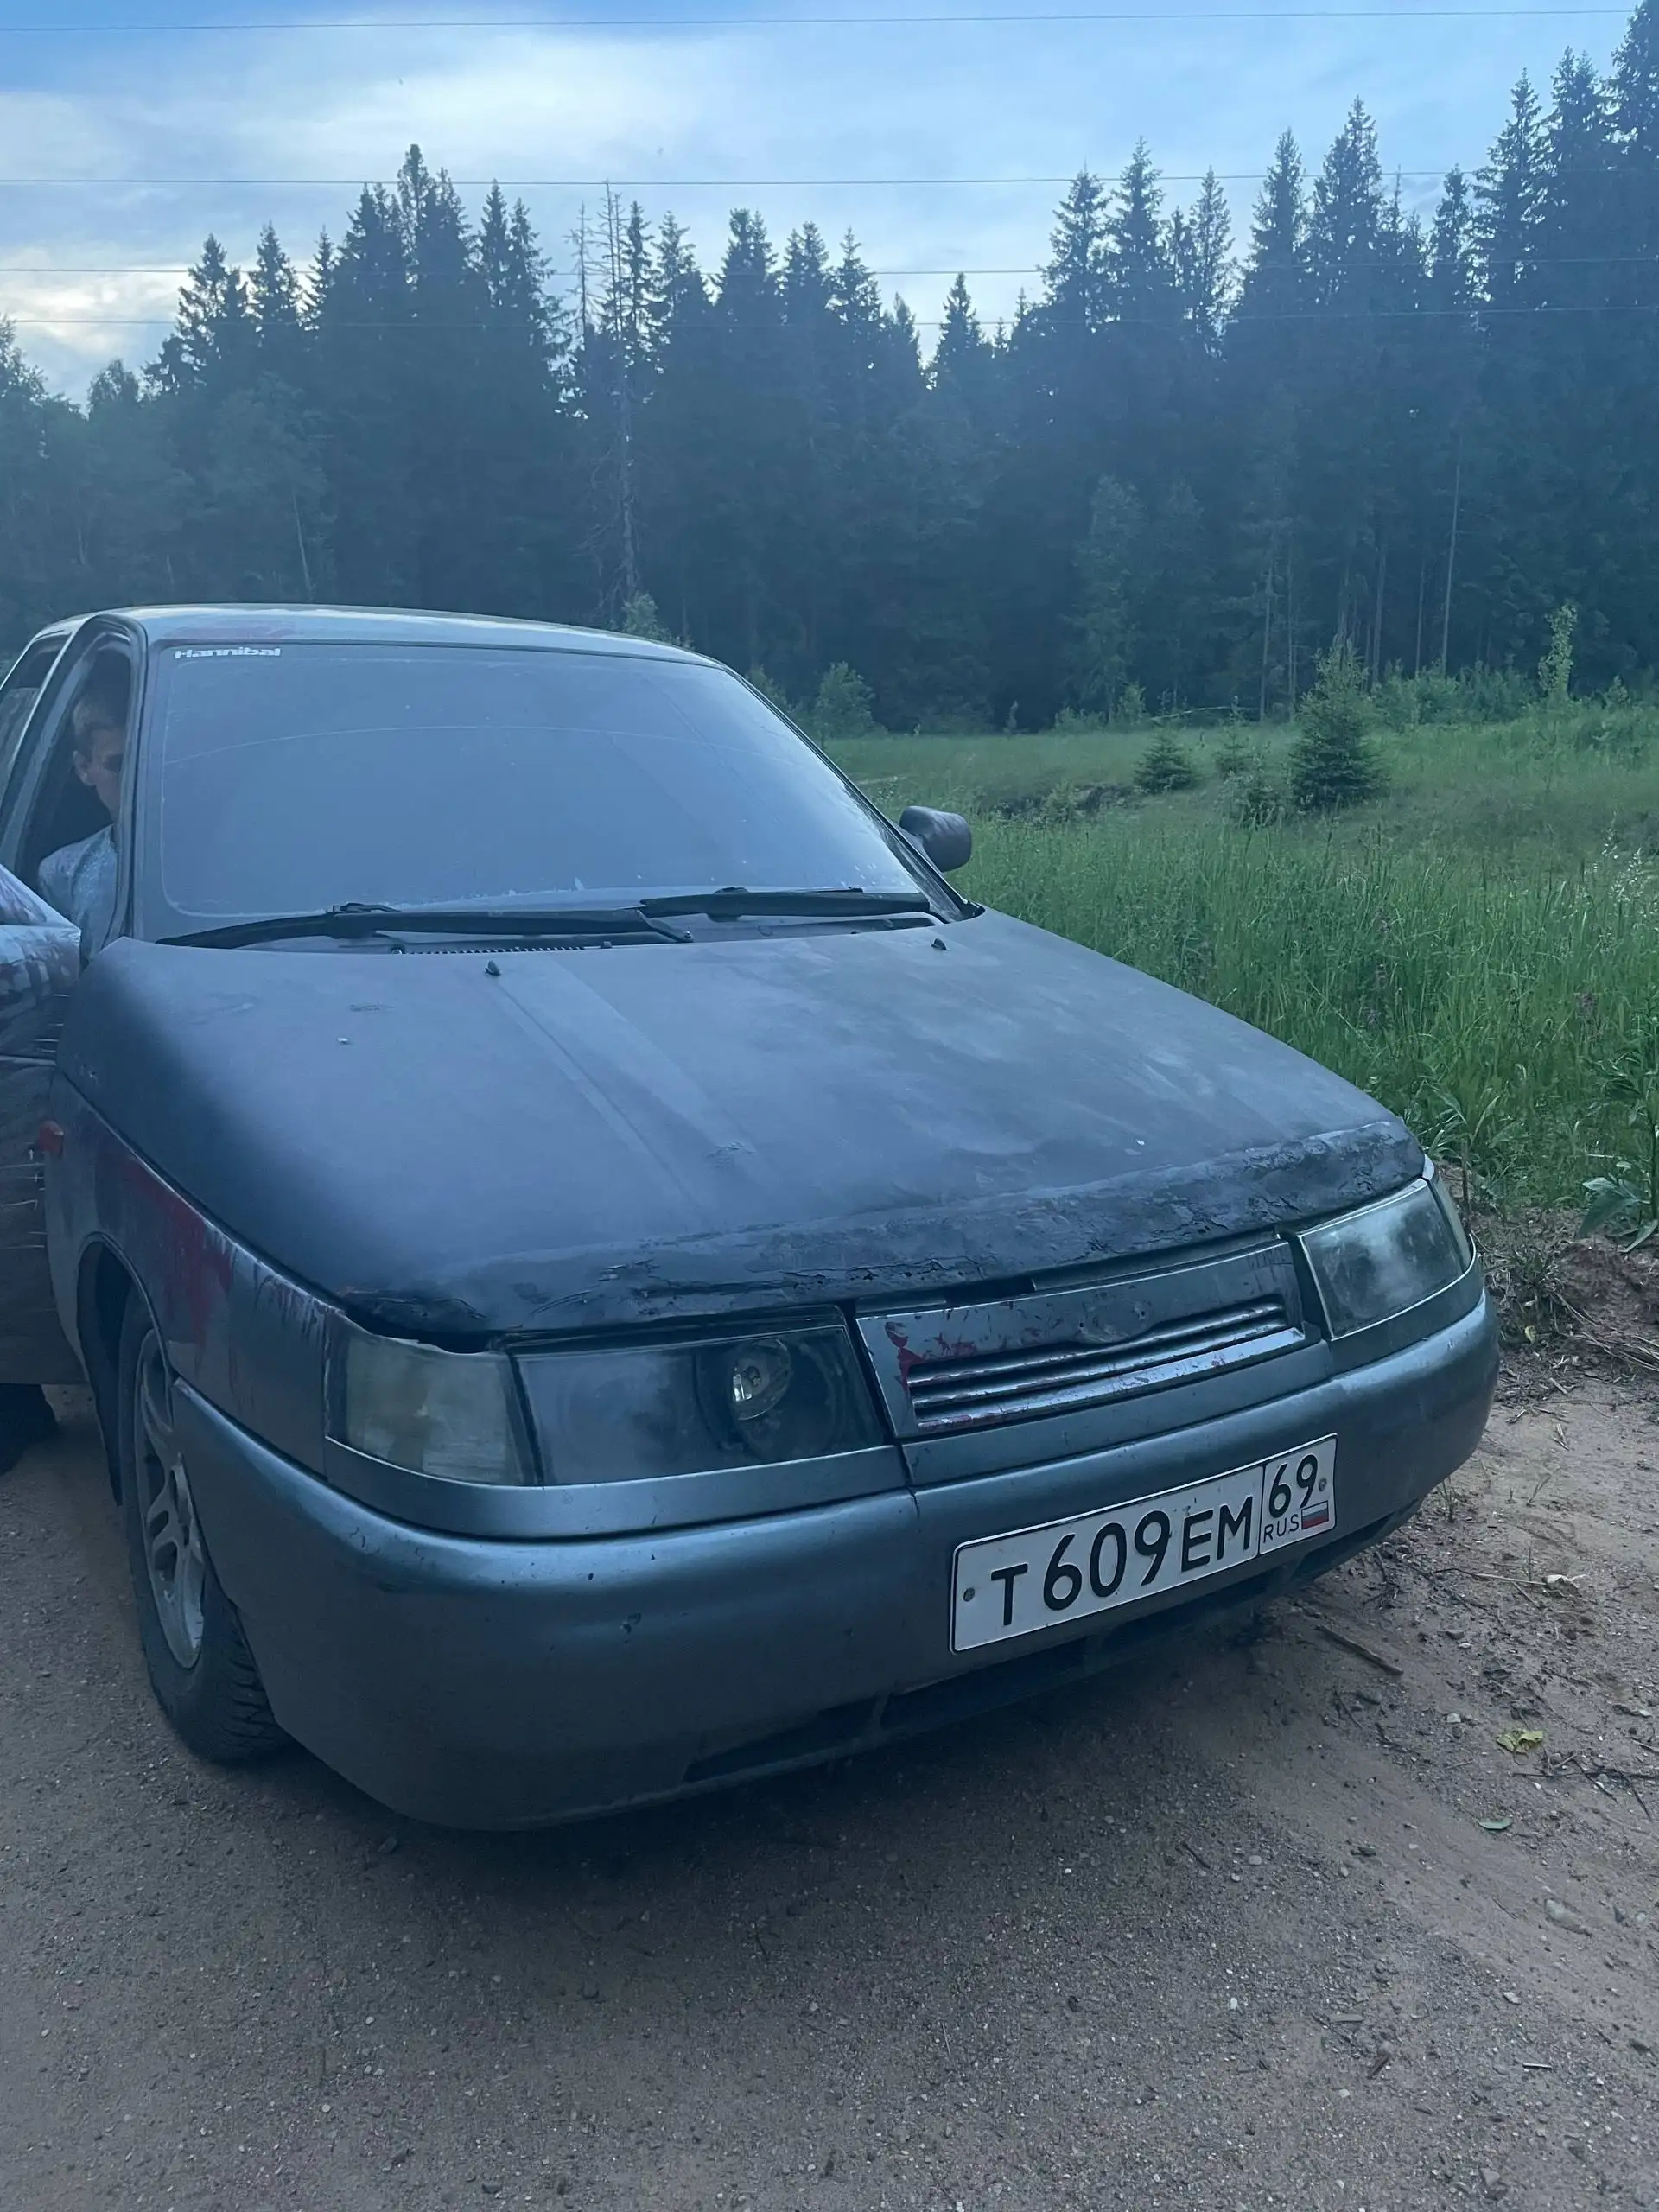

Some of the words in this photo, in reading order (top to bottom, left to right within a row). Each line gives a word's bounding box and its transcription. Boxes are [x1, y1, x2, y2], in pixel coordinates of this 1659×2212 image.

[175, 646, 281, 659] Hannibal
[1268, 1454, 1318, 1518] 69
[1263, 1514, 1300, 1544] RUS
